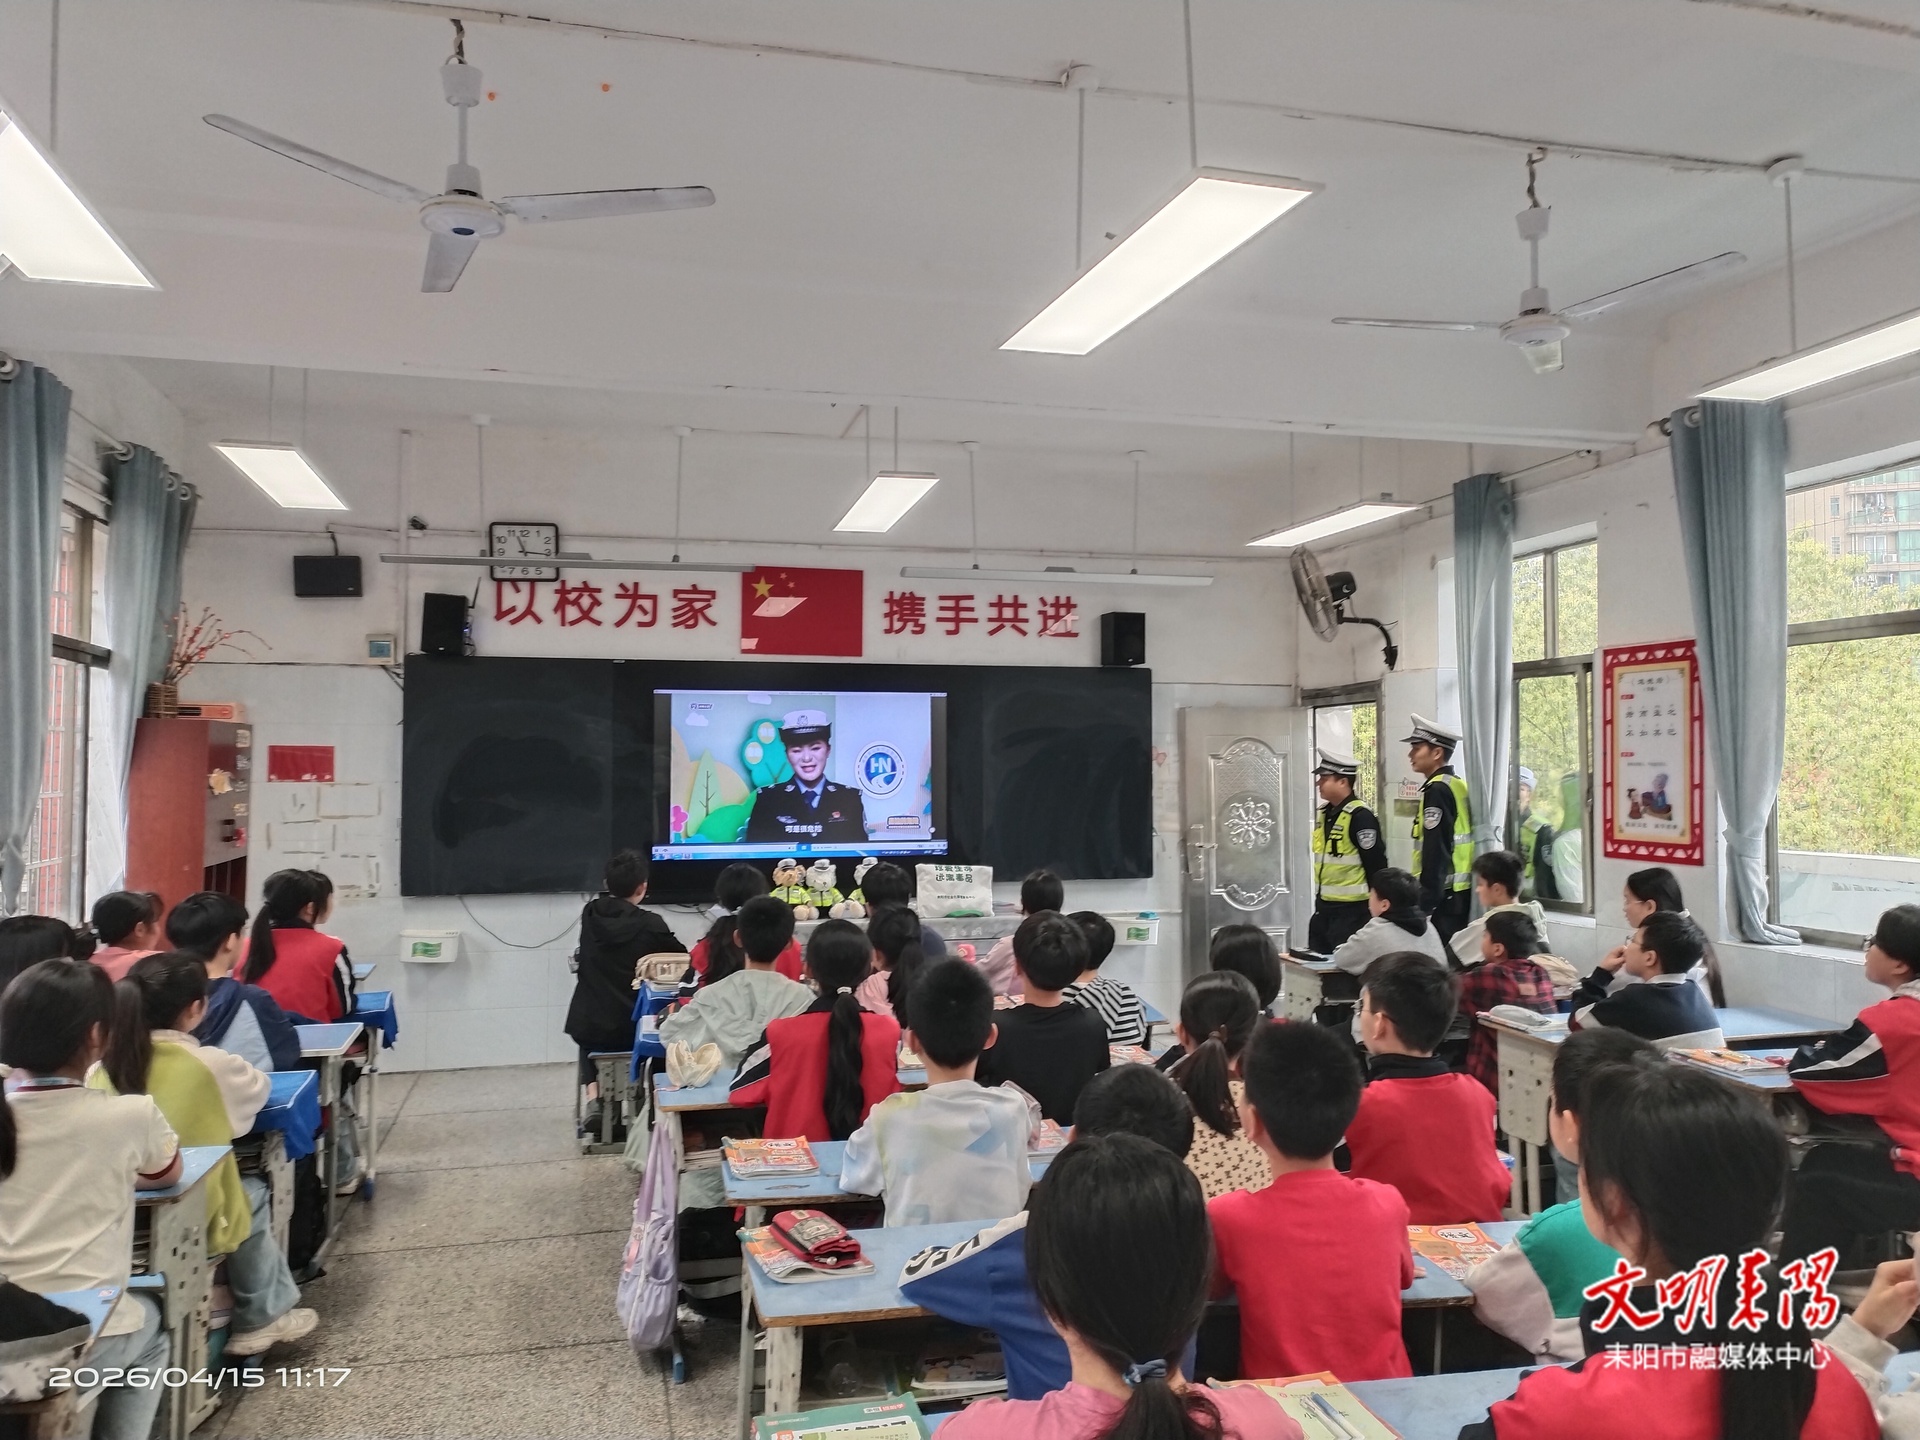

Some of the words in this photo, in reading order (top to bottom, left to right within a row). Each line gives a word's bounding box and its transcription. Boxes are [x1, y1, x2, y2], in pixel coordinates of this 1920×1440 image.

[518, 529, 531, 538] 12
[535, 530, 541, 538] 1
[495, 535, 507, 544] 10
[543, 536, 552, 545] 2
[497, 547, 506, 557] 9
[543, 548, 552, 557] 3
[507, 566, 516, 575] 7
[520, 567, 530, 576] 6
[534, 567, 543, 576] 5
[494, 580, 718, 630] 以校为家
[882, 590, 1080, 638] 携手共进
[1439, 1231, 1476, 1240] 语文
